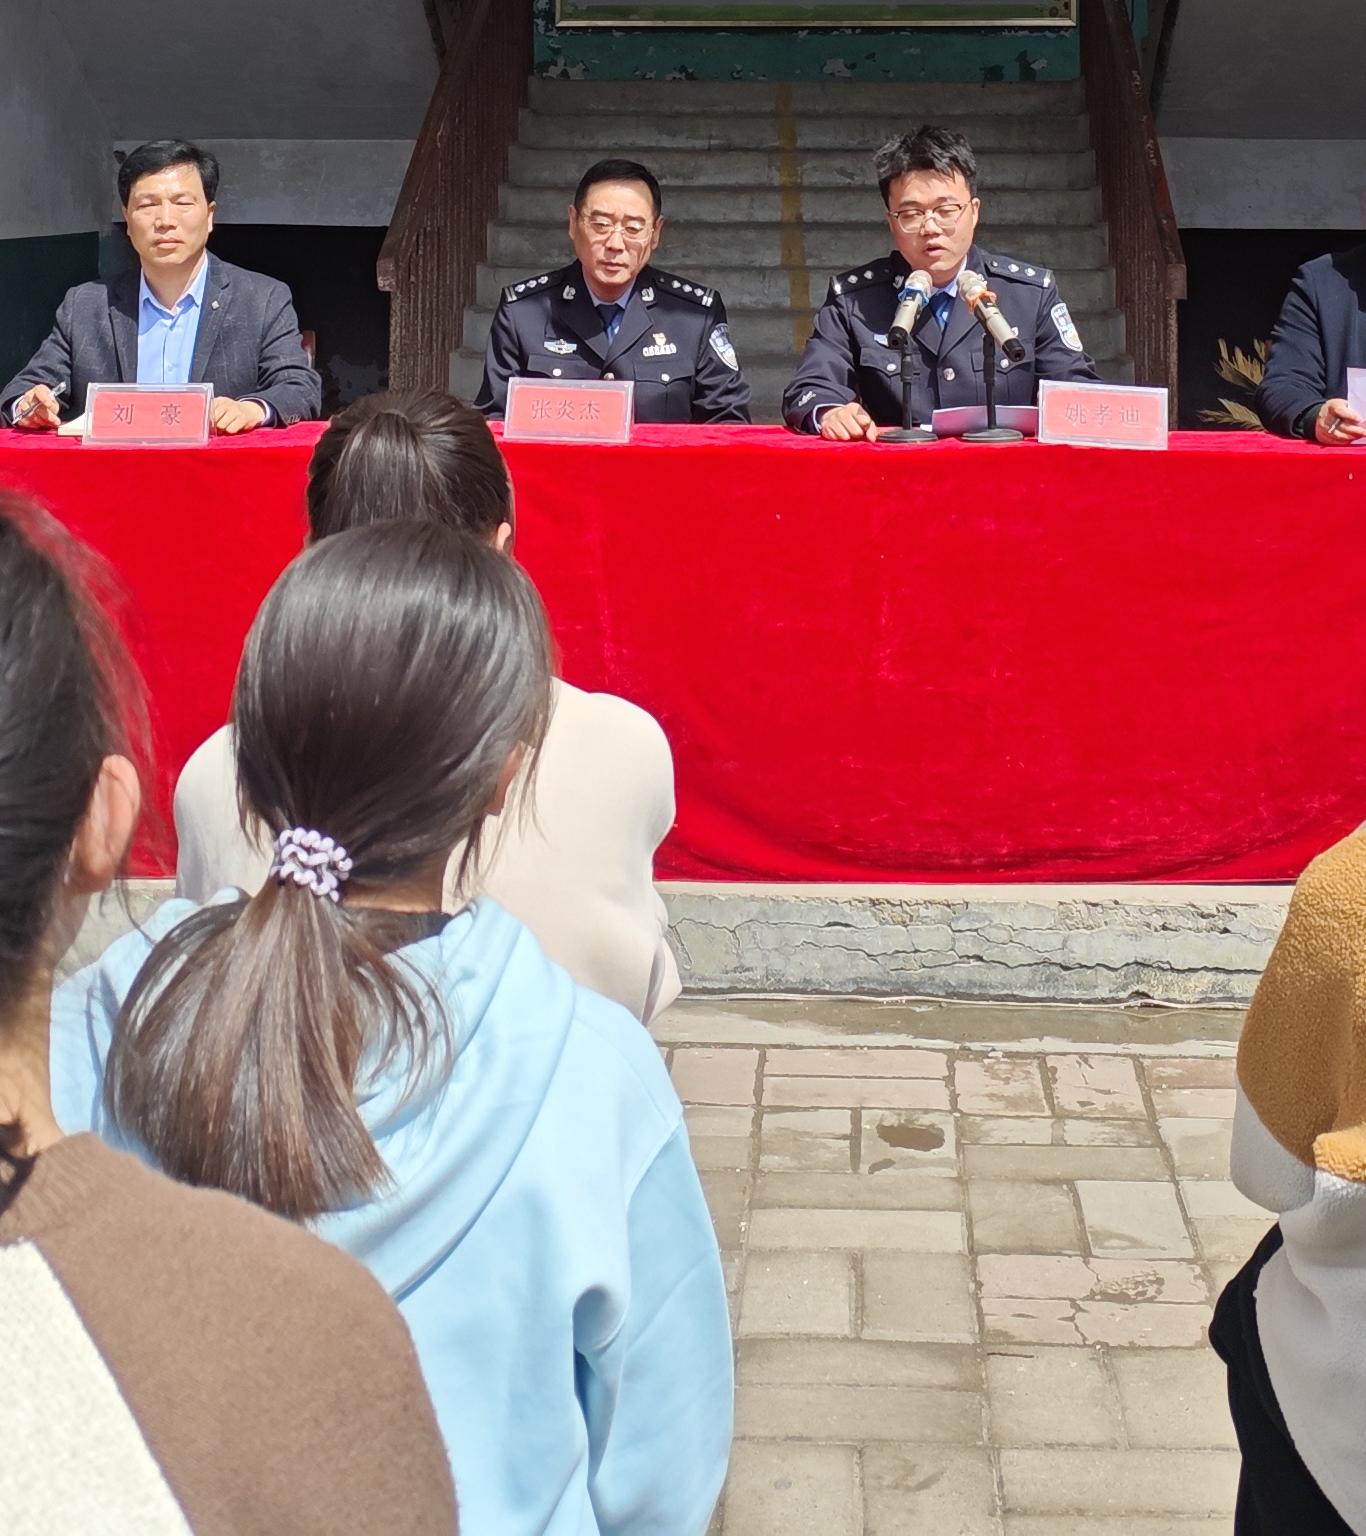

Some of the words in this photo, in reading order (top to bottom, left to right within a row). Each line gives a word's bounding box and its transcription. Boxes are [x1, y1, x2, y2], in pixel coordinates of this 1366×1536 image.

[531, 399, 601, 421] 张炎杰
[1065, 403, 1141, 427] 姚孝迪
